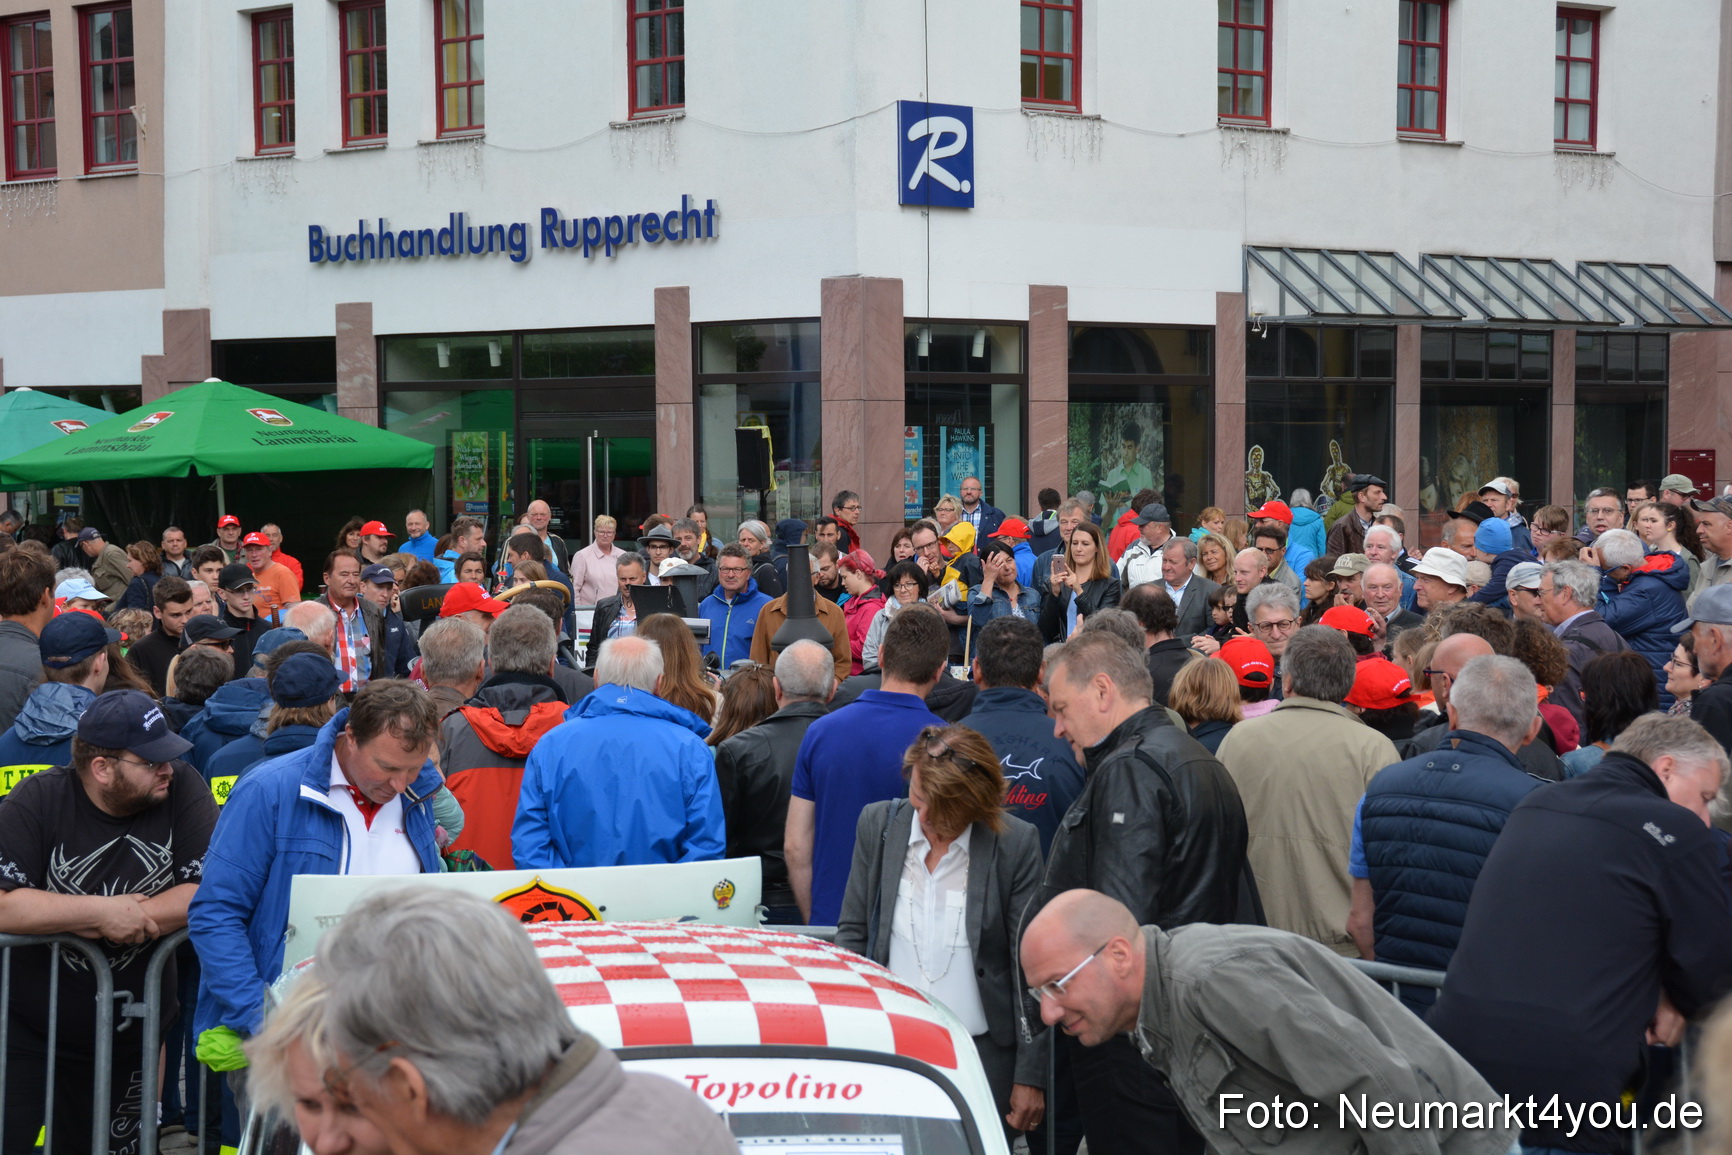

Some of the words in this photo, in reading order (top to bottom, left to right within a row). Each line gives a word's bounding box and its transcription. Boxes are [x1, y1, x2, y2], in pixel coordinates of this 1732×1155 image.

[308, 211, 528, 263] Buchhandlung
[541, 194, 716, 259] Rupprecht
[255, 428, 331, 437] Neumarkter
[251, 435, 358, 446] Lammsbräu
[64, 442, 152, 455] Lammsbräu
[953, 451, 971, 460] INTO
[956, 462, 969, 470] THE
[684, 1072, 863, 1107] Topolino
